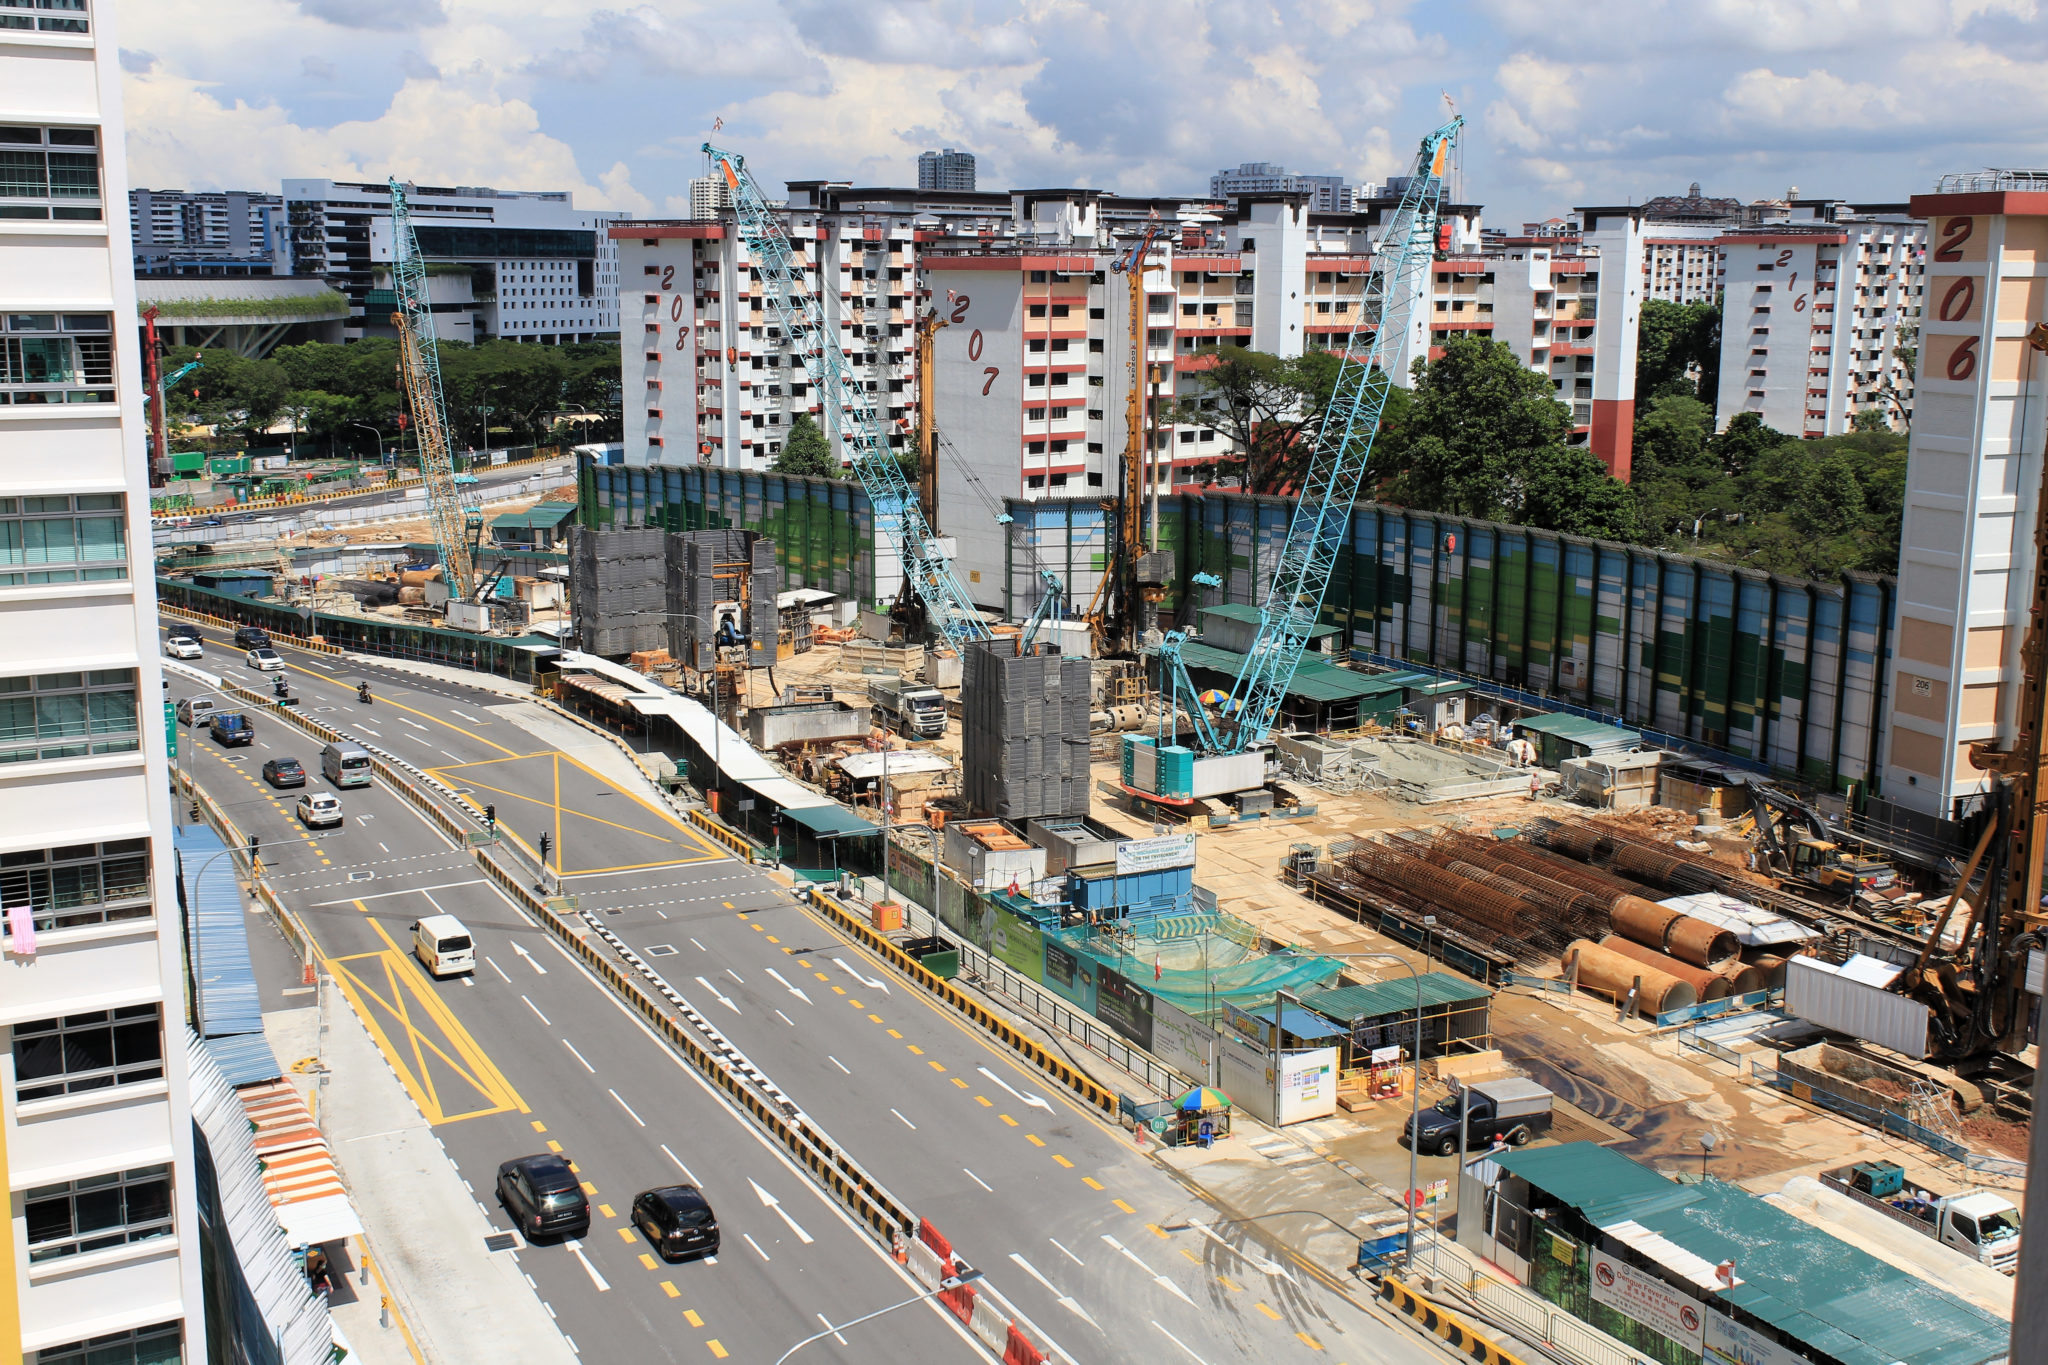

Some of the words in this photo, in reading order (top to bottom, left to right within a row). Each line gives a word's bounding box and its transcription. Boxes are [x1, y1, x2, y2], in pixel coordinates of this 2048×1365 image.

[661, 264, 690, 350] 208
[1776, 249, 1808, 312] 216
[1934, 216, 1980, 380] 206
[950, 295, 1000, 396] 207
[1915, 679, 1930, 690] 206
[1863, 1196, 1900, 1220] EQUIPMENT
[1914, 1220, 1928, 1232] LTD
[1616, 1271, 1642, 1289] Dengue
[1643, 1284, 1663, 1299] Fever
[1663, 1295, 1680, 1309] Alert
